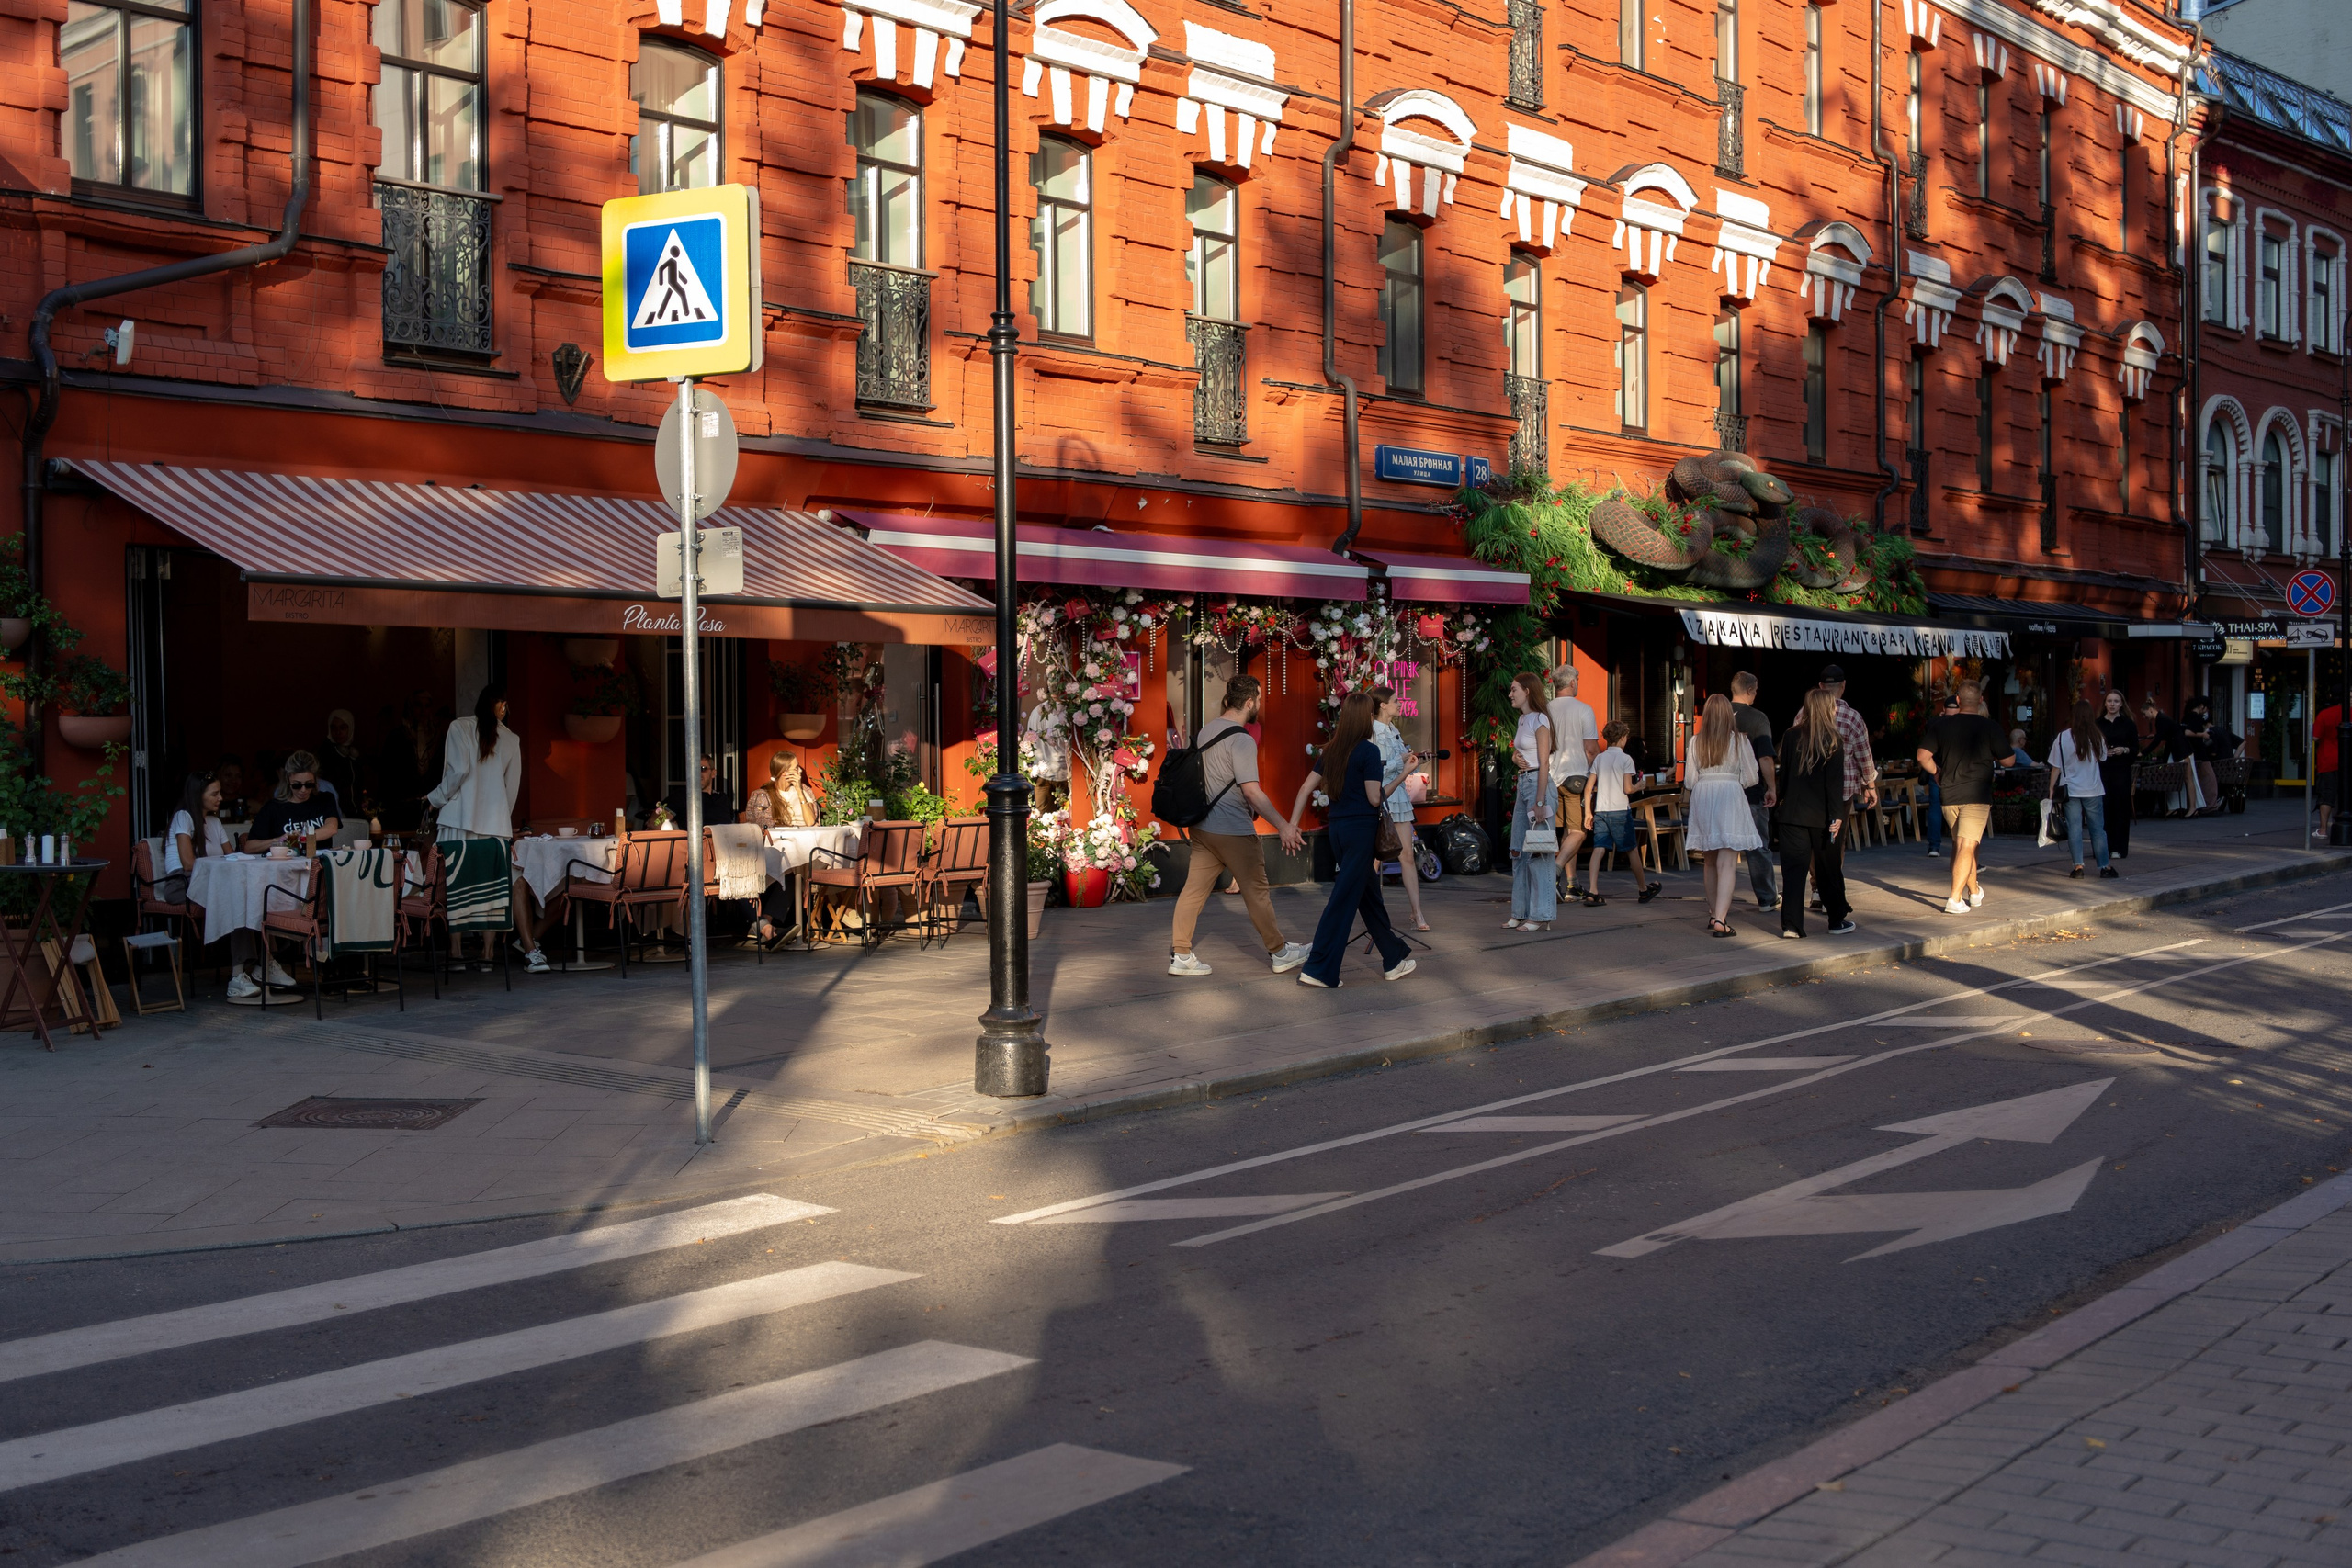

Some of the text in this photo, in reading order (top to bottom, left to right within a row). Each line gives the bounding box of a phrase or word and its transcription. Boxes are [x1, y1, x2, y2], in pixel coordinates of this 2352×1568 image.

[1392, 454, 1452, 472] МАЛАЯ БРОННАЯ
[1475, 465, 1487, 481] 28
[253, 587, 345, 609] MARGARITA
[285, 612, 310, 620] BISTRO
[623, 604, 683, 631] Planta
[945, 618, 997, 634] MARGARIT
[1688, 617, 1762, 638] IZAKAYA
[2228, 621, 2278, 634] THAI-SPA
[1394, 660, 1419, 678] PINK
